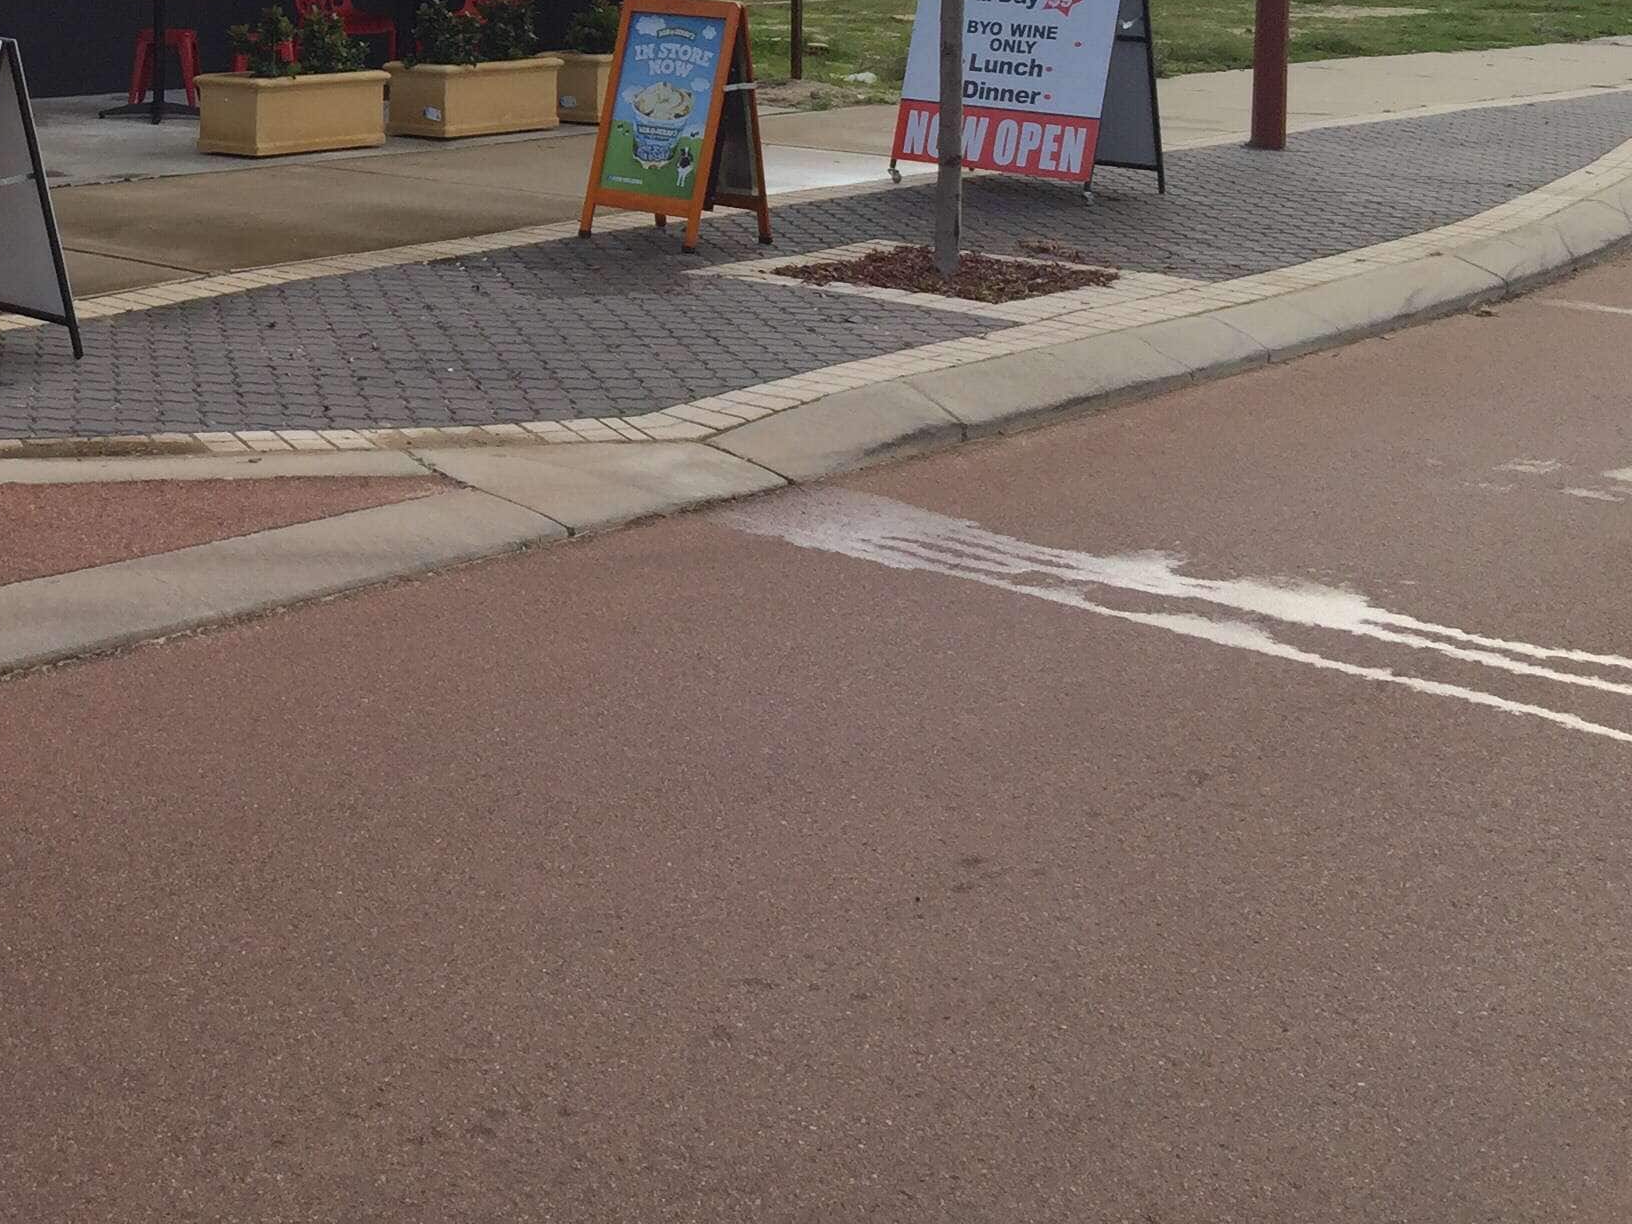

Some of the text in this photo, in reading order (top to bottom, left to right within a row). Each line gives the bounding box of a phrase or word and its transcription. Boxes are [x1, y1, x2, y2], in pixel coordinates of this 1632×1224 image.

[967, 20, 1058, 40] BYO WINE
[634, 42, 715, 67] IN STORE
[990, 38, 1037, 54] ONLY
[649, 58, 694, 77] NOW
[969, 54, 1043, 78] Lunch
[962, 80, 1041, 106] Dinner
[993, 119, 1088, 174] OPEN
